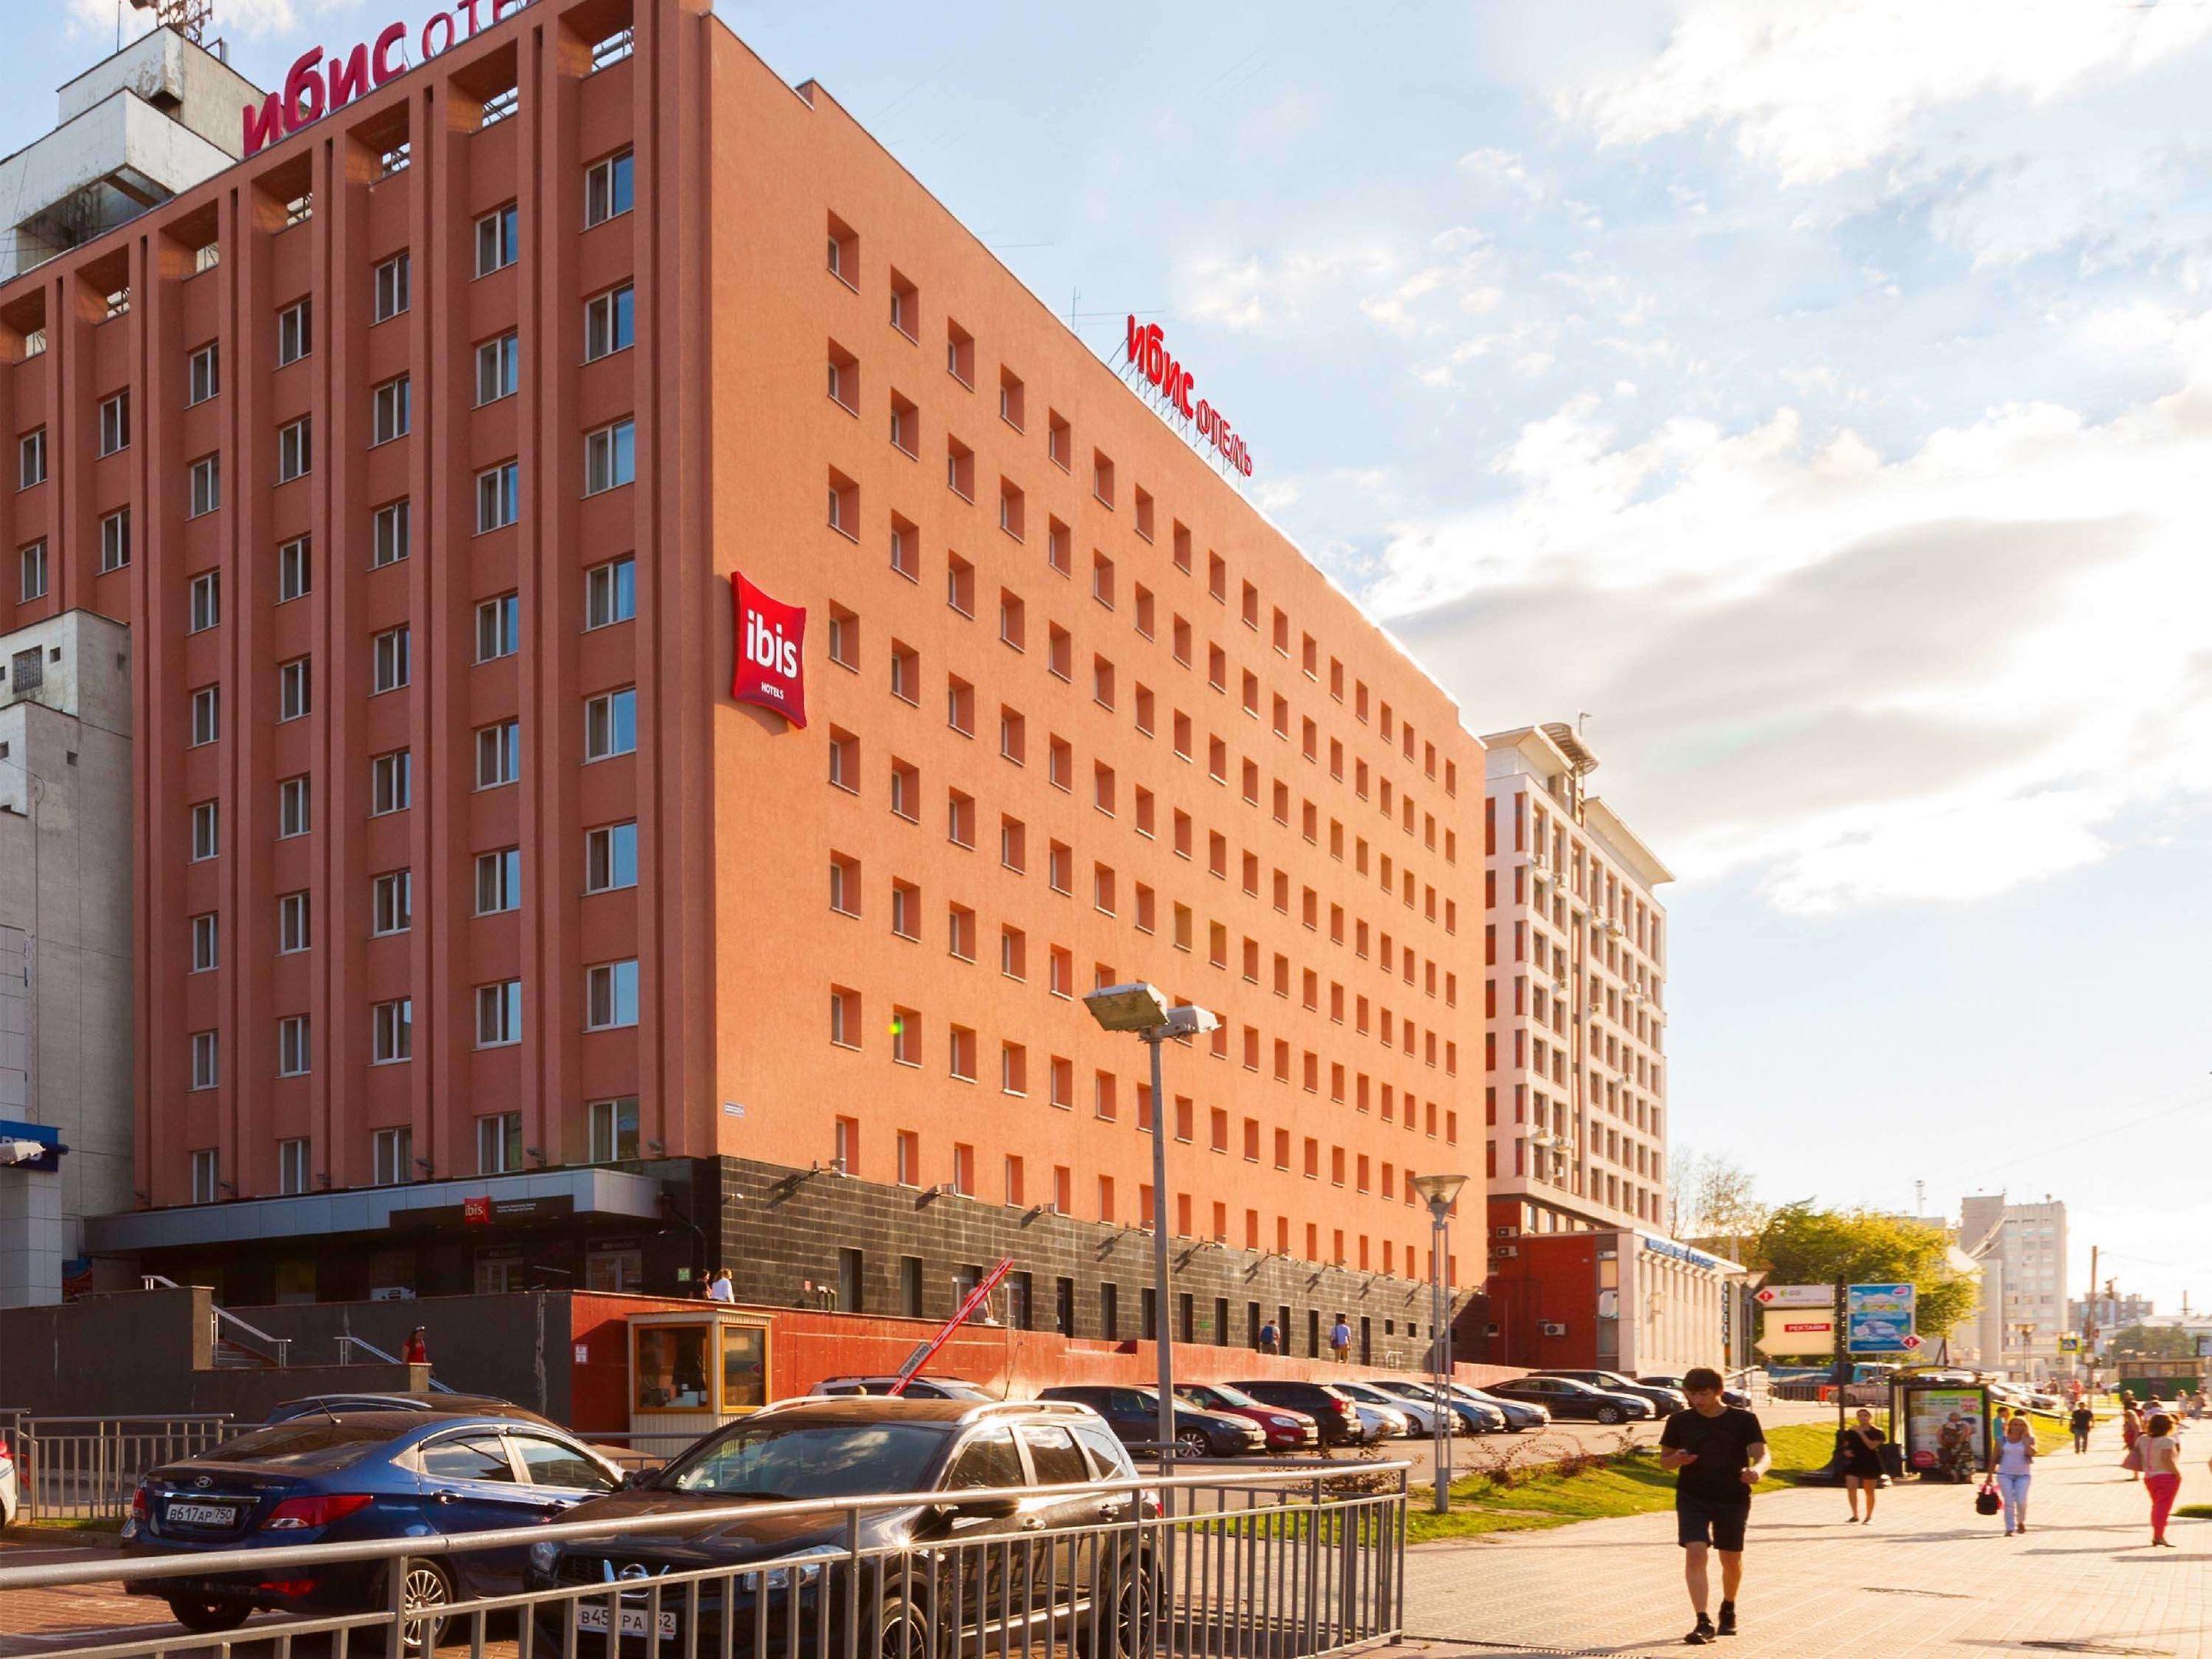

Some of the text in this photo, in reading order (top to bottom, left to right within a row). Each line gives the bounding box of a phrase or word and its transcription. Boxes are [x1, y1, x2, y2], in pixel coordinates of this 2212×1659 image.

[747, 608, 798, 679] ibis
[761, 681, 784, 700] HOTELS
[464, 1204, 484, 1217] ibis
[215, 1508, 233, 1519] 750
[581, 1609, 643, 1630] В45РА
